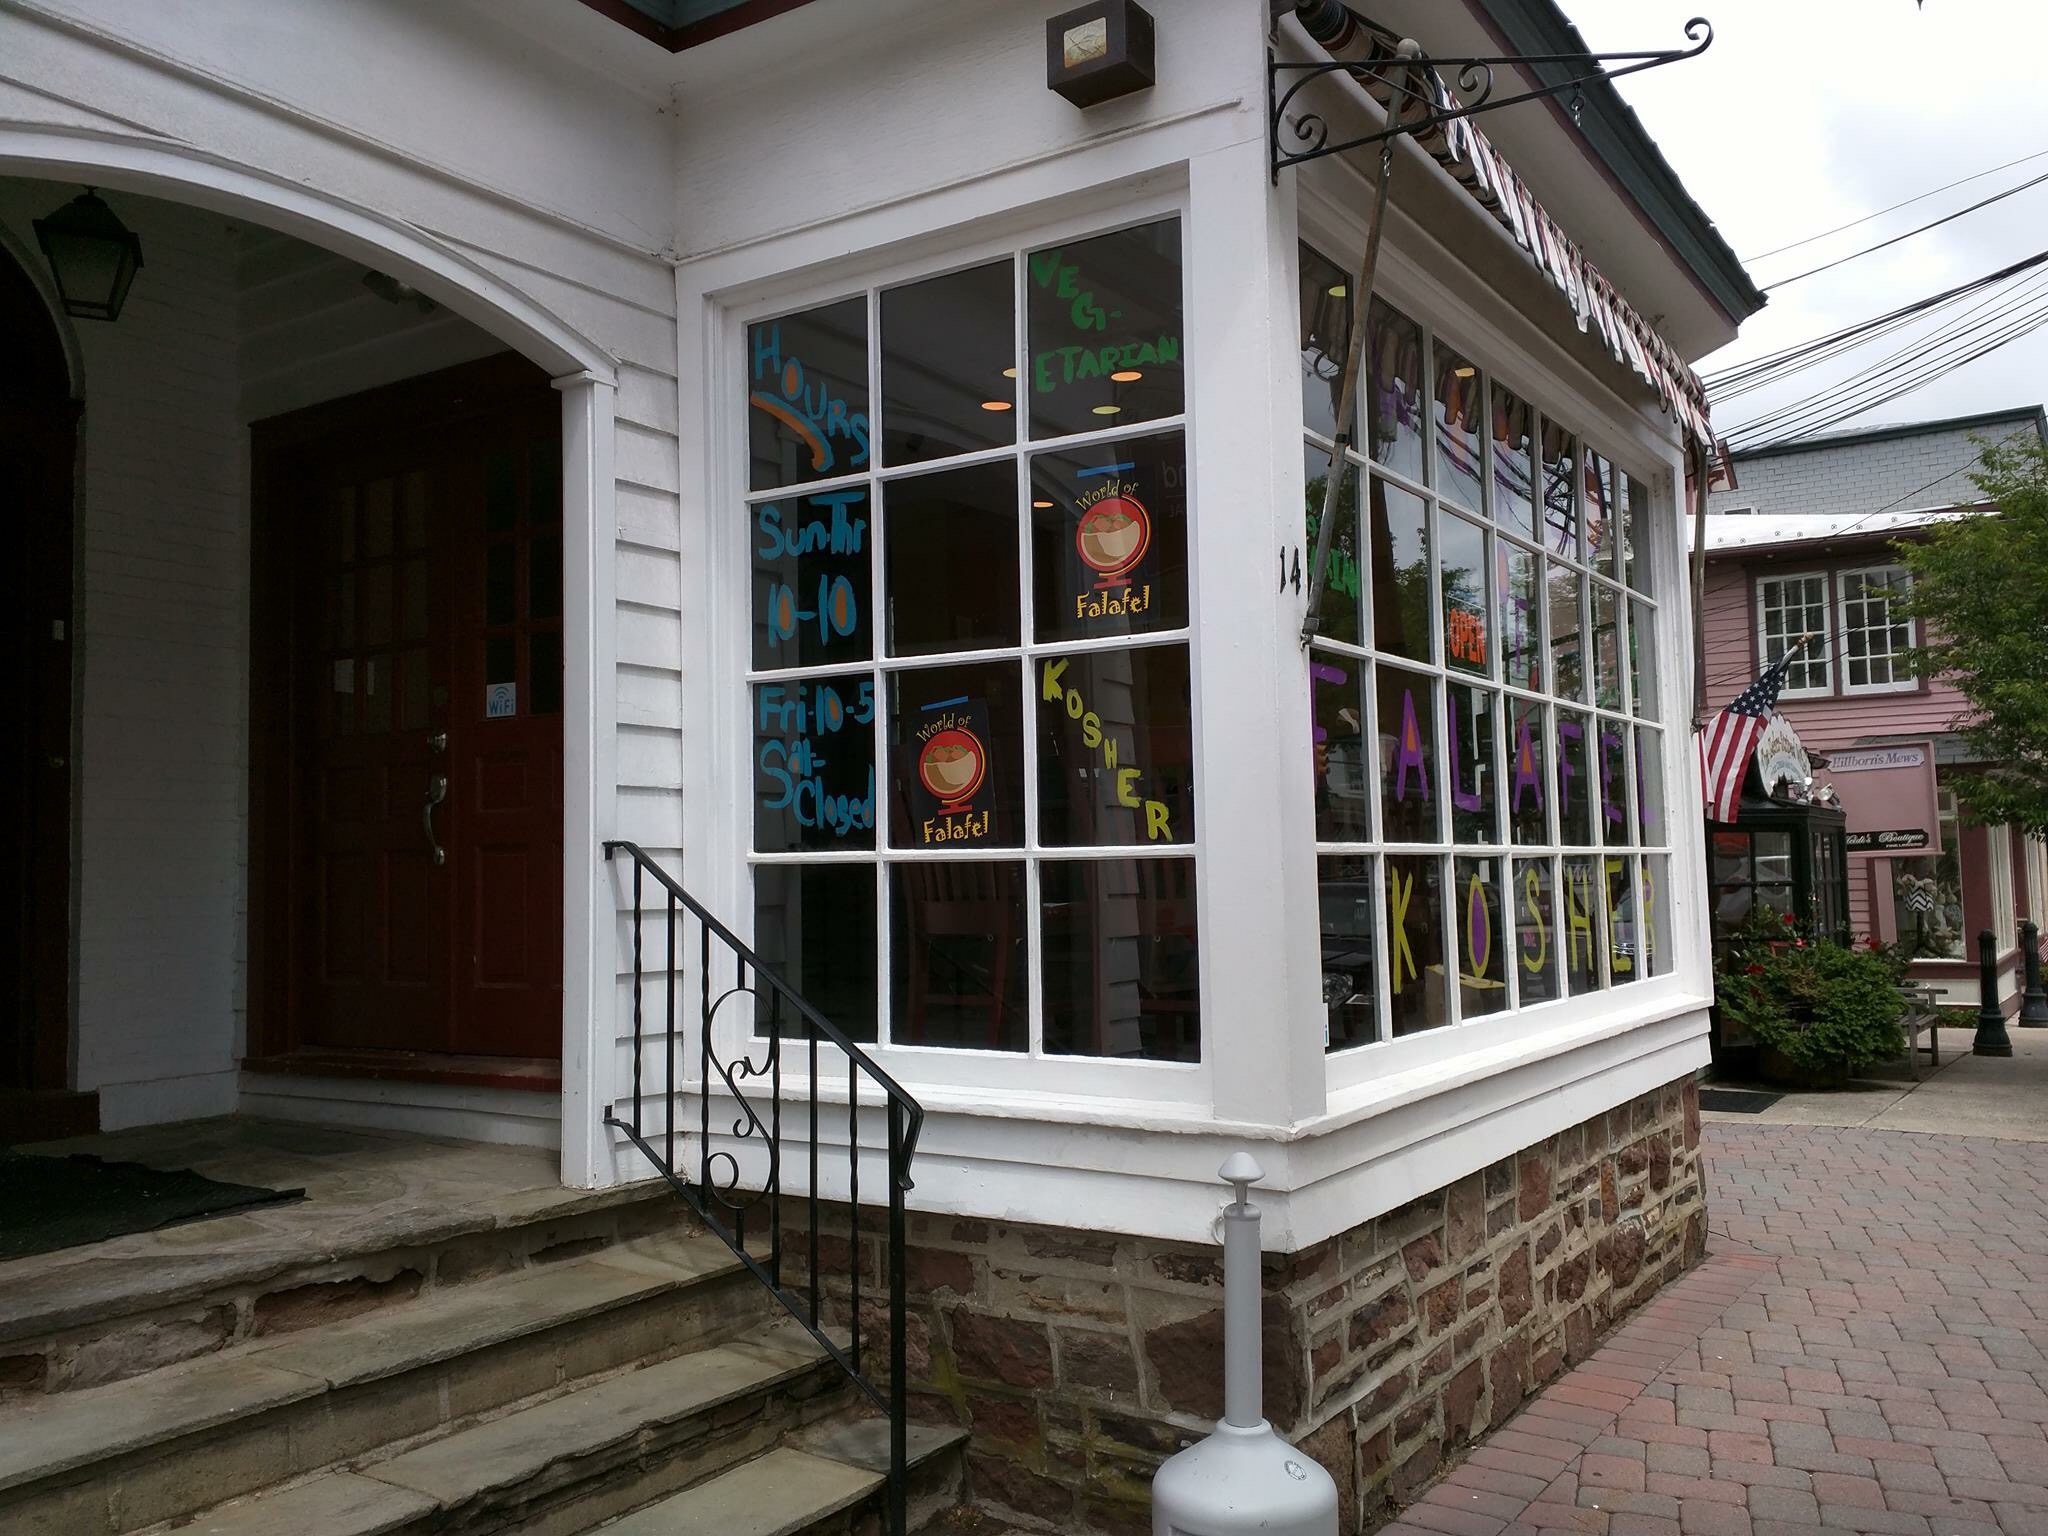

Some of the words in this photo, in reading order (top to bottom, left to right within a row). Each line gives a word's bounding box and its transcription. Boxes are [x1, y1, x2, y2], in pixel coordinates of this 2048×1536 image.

[1035, 335, 1178, 393] ETARIAN
[1075, 479, 1121, 510] World
[1123, 482, 1139, 496] of
[1280, 545, 1301, 596] 14
[1076, 585, 1150, 618] Falafel
[1449, 607, 1486, 665] OPEN
[916, 713, 956, 742] World
[958, 715, 972, 729] of
[1310, 661, 1656, 825] FALAFEL
[1043, 657, 1173, 842] KOSHER
[1885, 753, 1919, 765] Mews
[924, 811, 989, 844] Falafel
[1878, 831, 1925, 845] Boutique
[1391, 859, 1657, 995] KOSHER
